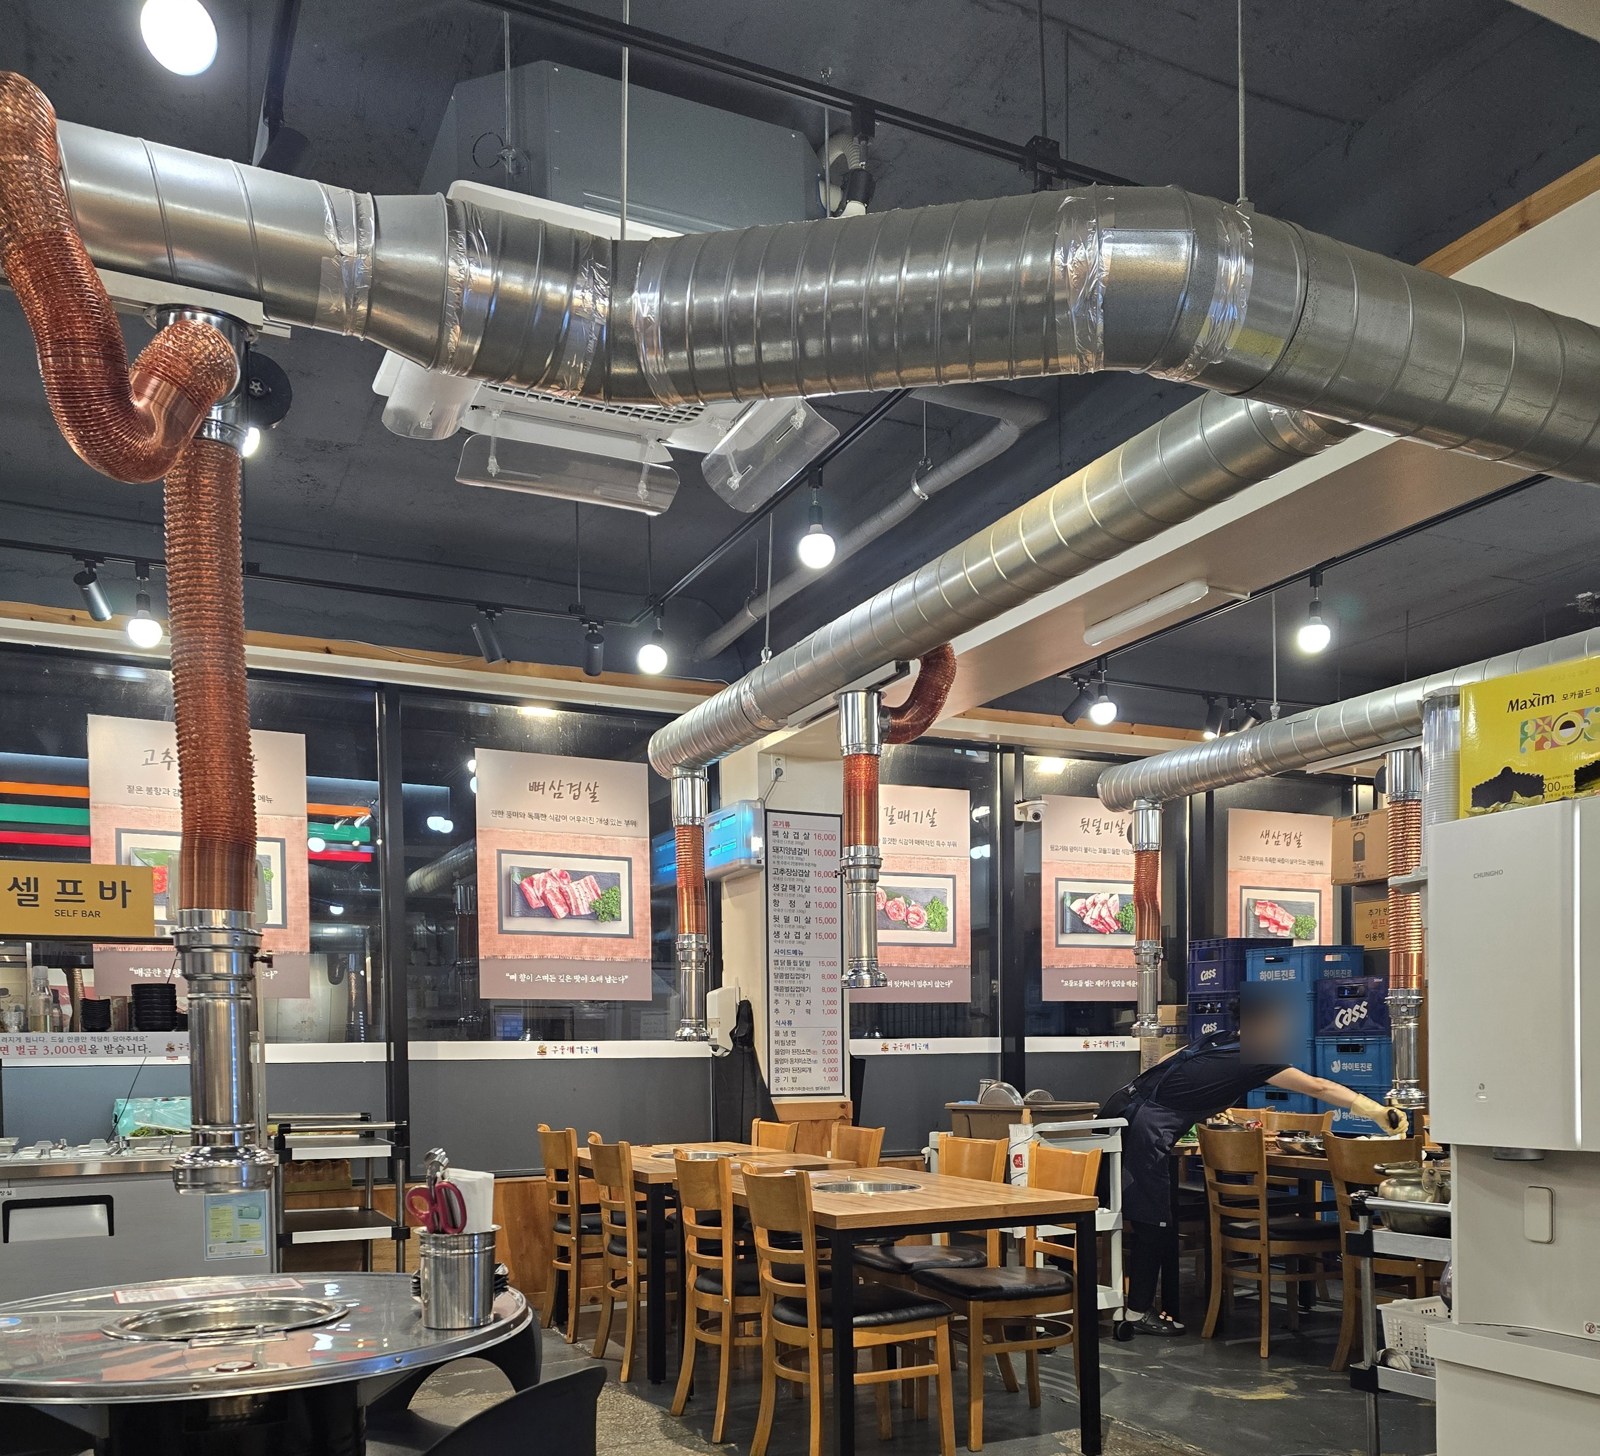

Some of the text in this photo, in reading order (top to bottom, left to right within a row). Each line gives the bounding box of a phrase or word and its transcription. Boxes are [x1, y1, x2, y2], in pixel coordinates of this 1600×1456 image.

[1507, 693, 1555, 713] Maxim
[1562, 688, 1591, 701] 모카골드
[141, 747, 176, 771] 고추
[529, 780, 600, 803] 뼈삼겹살
[258, 795, 273, 803] 메뉴
[506, 811, 526, 819] 풍미와
[549, 813, 567, 822] 식감이
[569, 815, 594, 825] 어우러진
[610, 818, 622, 826] 있는
[1080, 817, 1125, 837] 뒷덜미살
[813, 833, 837, 841] 16,000
[1260, 830, 1303, 848] 생삼겹살
[813, 849, 837, 857] 16,000
[814, 886, 837, 894] 16,000
[814, 901, 837, 909] 16,000
[54, 909, 101, 918] SELF BAR
[1368, 908, 1381, 916] 추가
[815, 932, 837, 940] 15,000
[1259, 969, 1296, 981] 하이트진로
[1323, 969, 1352, 978] 하이트진로
[15, 1045, 39, 1055] 벌금
[43, 1044, 99, 1055] 3,000원을
[104, 1043, 152, 1055] 받습니다.
[1341, 1062, 1373, 1071] 하이트진로
